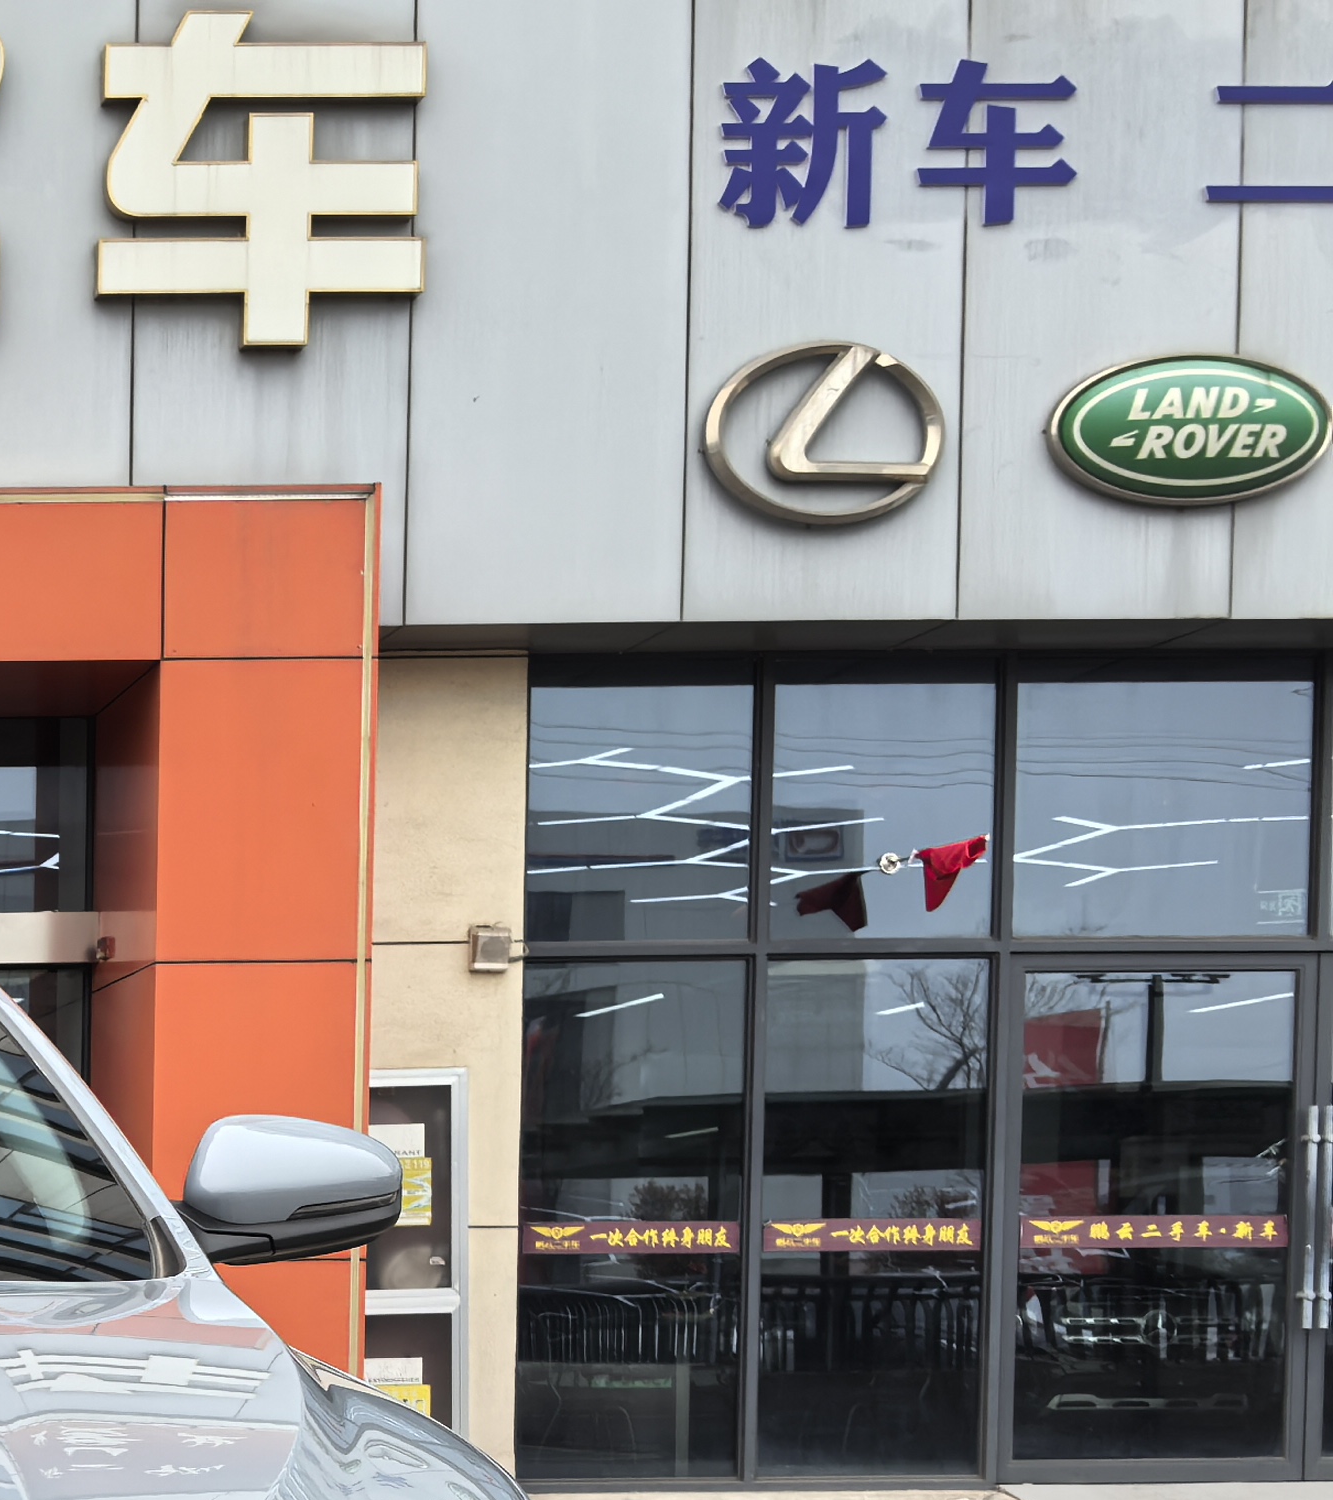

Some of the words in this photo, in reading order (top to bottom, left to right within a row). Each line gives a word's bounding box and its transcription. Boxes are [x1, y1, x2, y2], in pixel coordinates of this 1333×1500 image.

[717, 56, 1078, 230] 新车
[1127, 386, 1251, 421] LAND
[1134, 423, 1288, 460] ROVER
[589, 1225, 732, 1249] 一次合作终身朋友
[830, 1222, 974, 1246] 一次合作终身朋友
